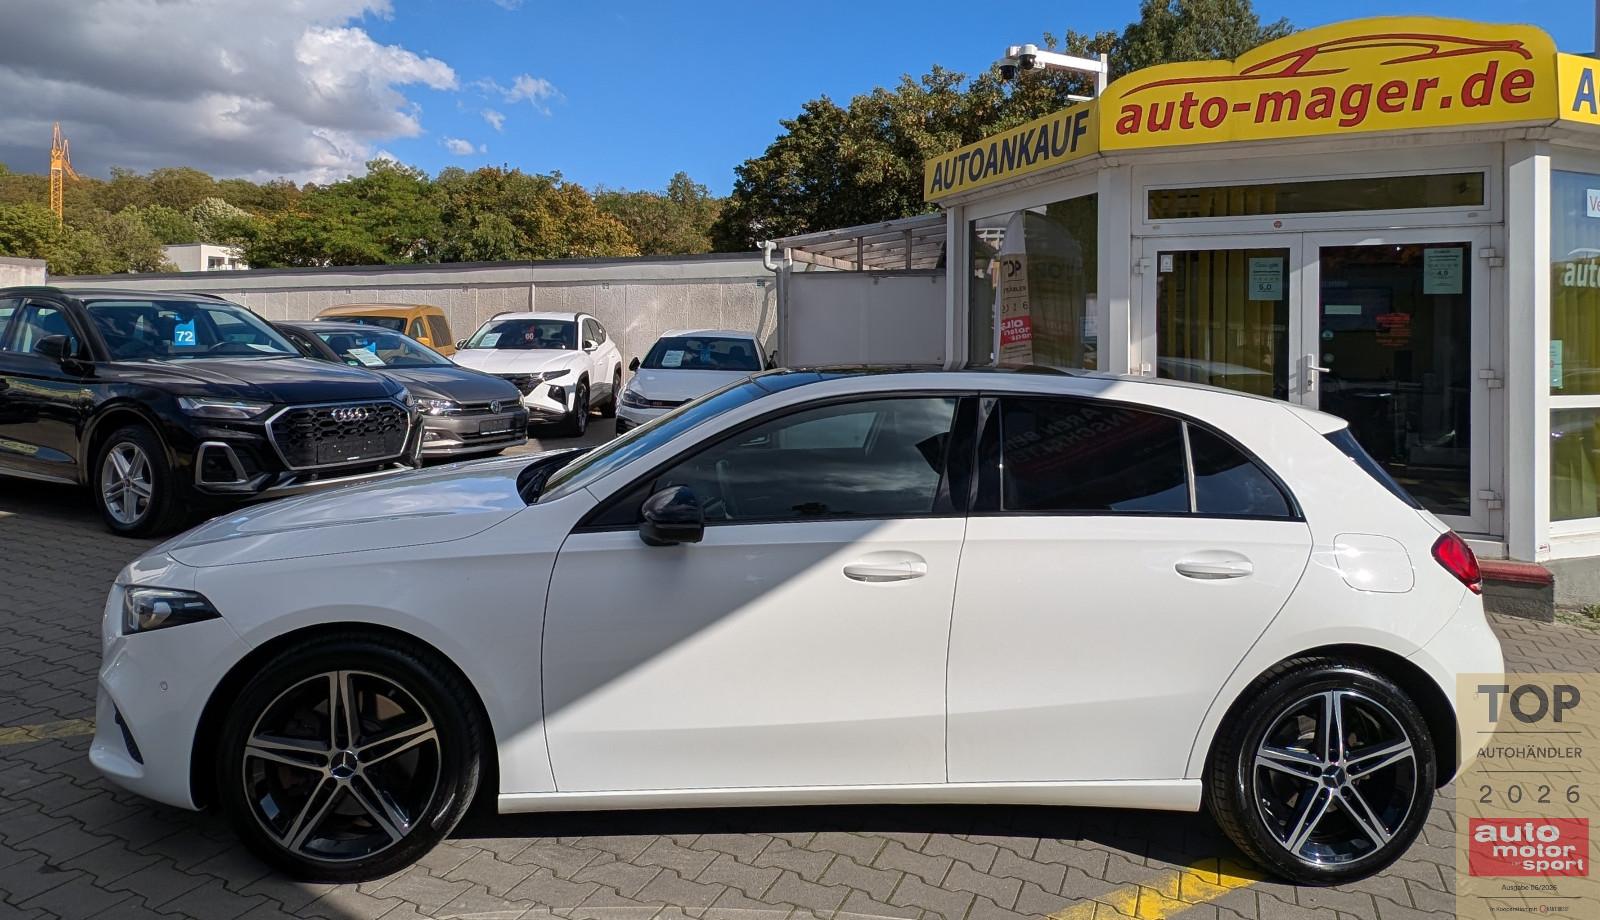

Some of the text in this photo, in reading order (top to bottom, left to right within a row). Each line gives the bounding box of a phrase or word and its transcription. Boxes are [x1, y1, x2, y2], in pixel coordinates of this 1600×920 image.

[1115, 60, 1535, 136] auto-mager.de
[930, 109, 1089, 194] AUTOANKAUF
[175, 330, 193, 342] 72
